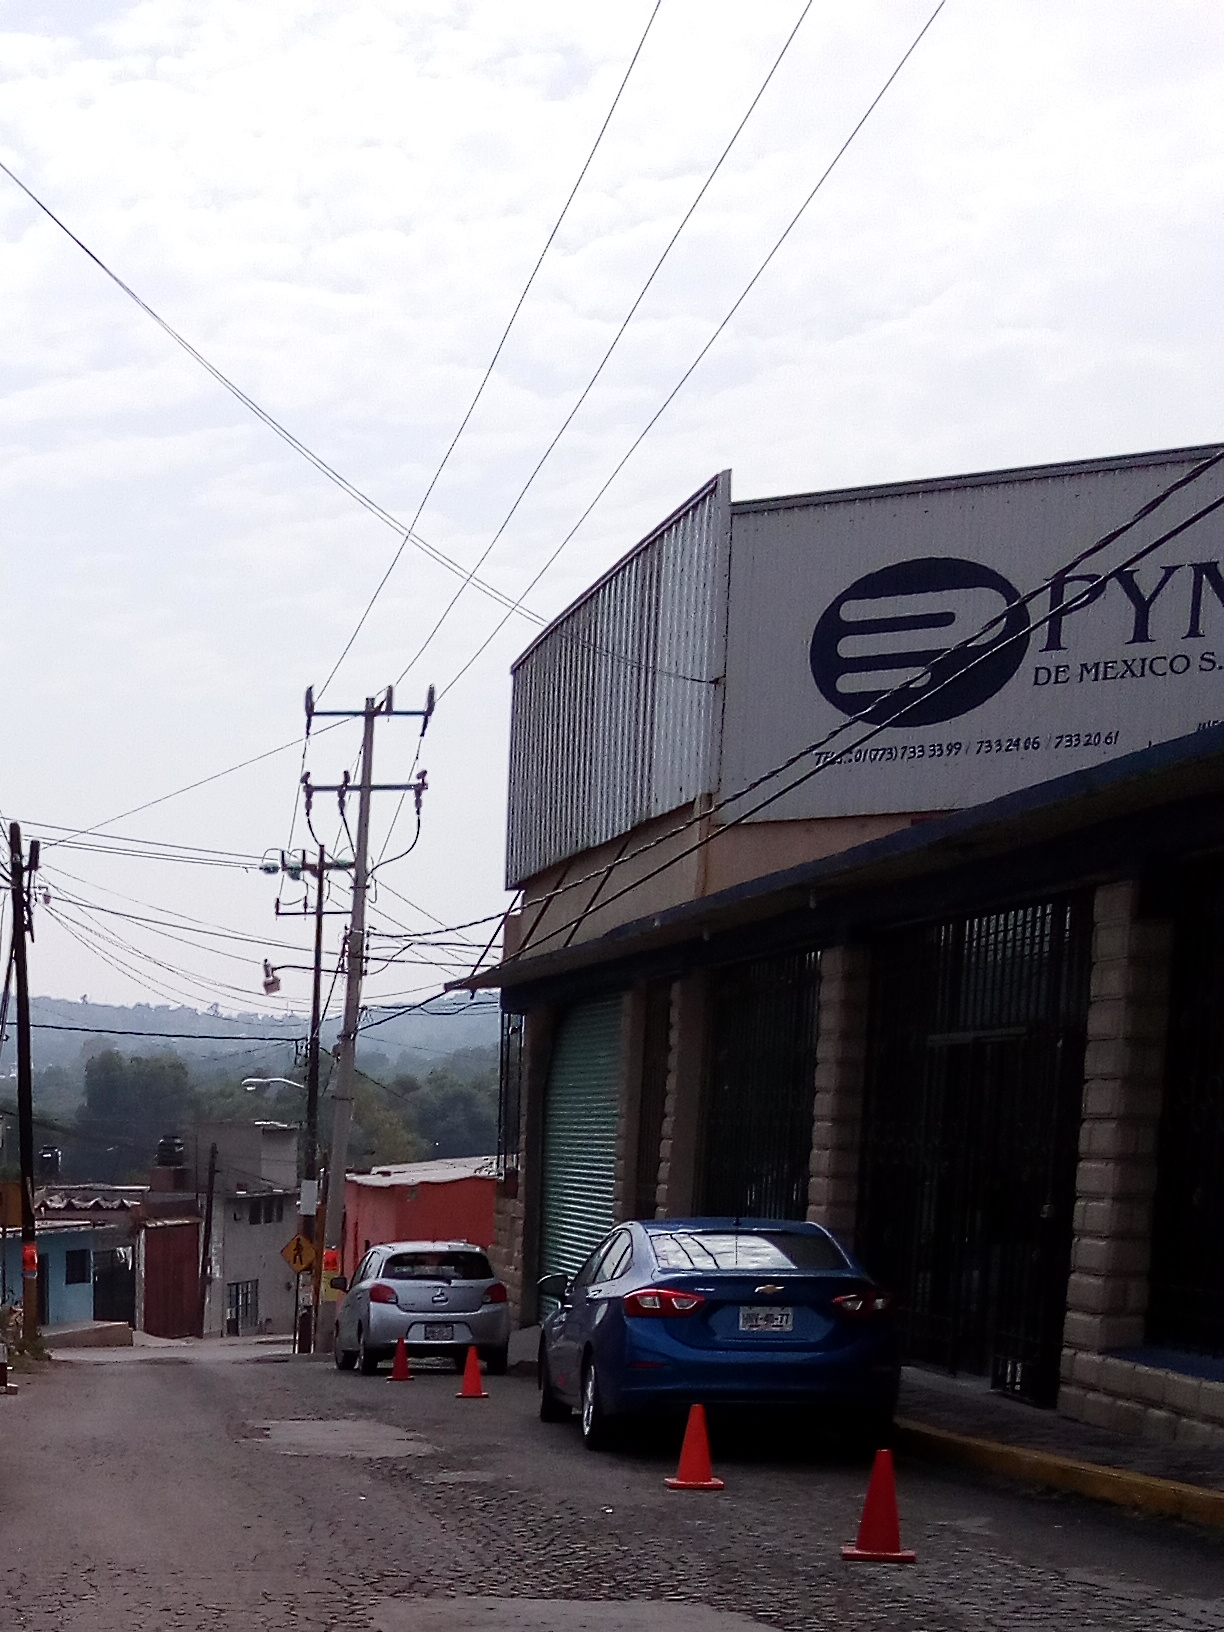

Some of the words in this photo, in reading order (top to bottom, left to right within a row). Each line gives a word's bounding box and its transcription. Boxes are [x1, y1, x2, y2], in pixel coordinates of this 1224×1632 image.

[1032, 664, 1069, 687] DE
[1078, 654, 1191, 683] MEXICO
[1198, 651, 1224, 672] S.
